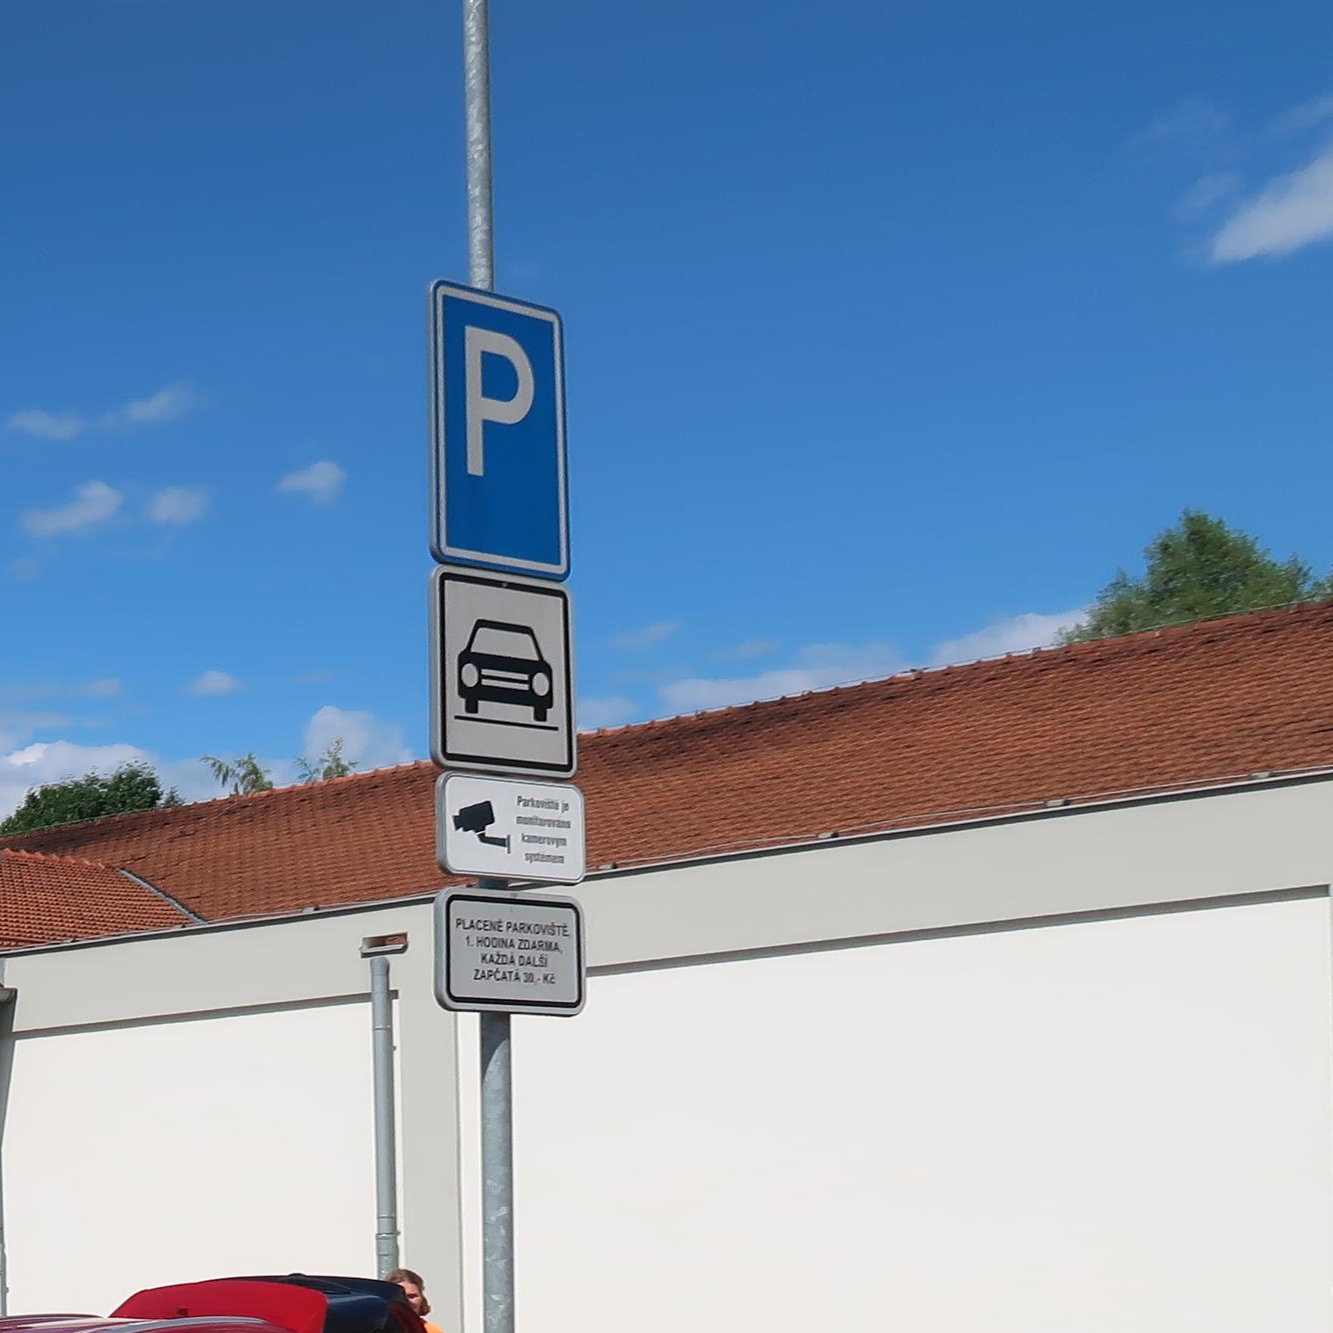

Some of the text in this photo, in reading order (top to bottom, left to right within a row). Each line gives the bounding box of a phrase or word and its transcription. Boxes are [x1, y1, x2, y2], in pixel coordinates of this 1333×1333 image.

[465, 325, 535, 476] P
[455, 918, 503, 932] PLACENÉ
[465, 936, 474, 947] 1.
[476, 936, 515, 949] HODINA
[481, 951, 548, 968] KAŽDÁ DALŠÍ
